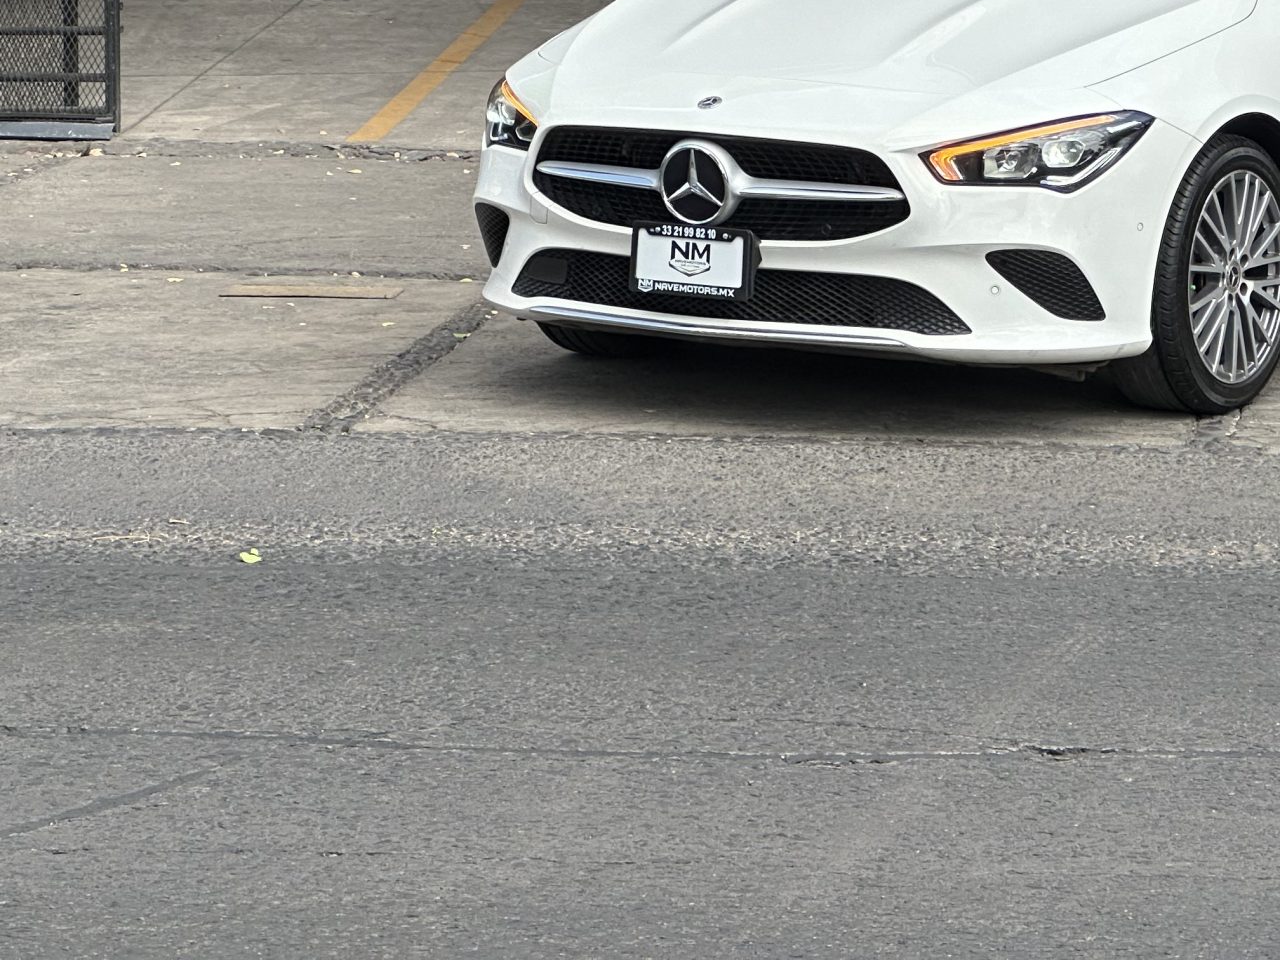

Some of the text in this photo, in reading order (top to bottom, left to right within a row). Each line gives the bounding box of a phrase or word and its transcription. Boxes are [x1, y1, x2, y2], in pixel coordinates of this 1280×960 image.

[662, 224, 717, 240] 33 21 99 82 10
[670, 240, 711, 264] NM
[655, 282, 735, 298] NAVEMOTORS.MX
